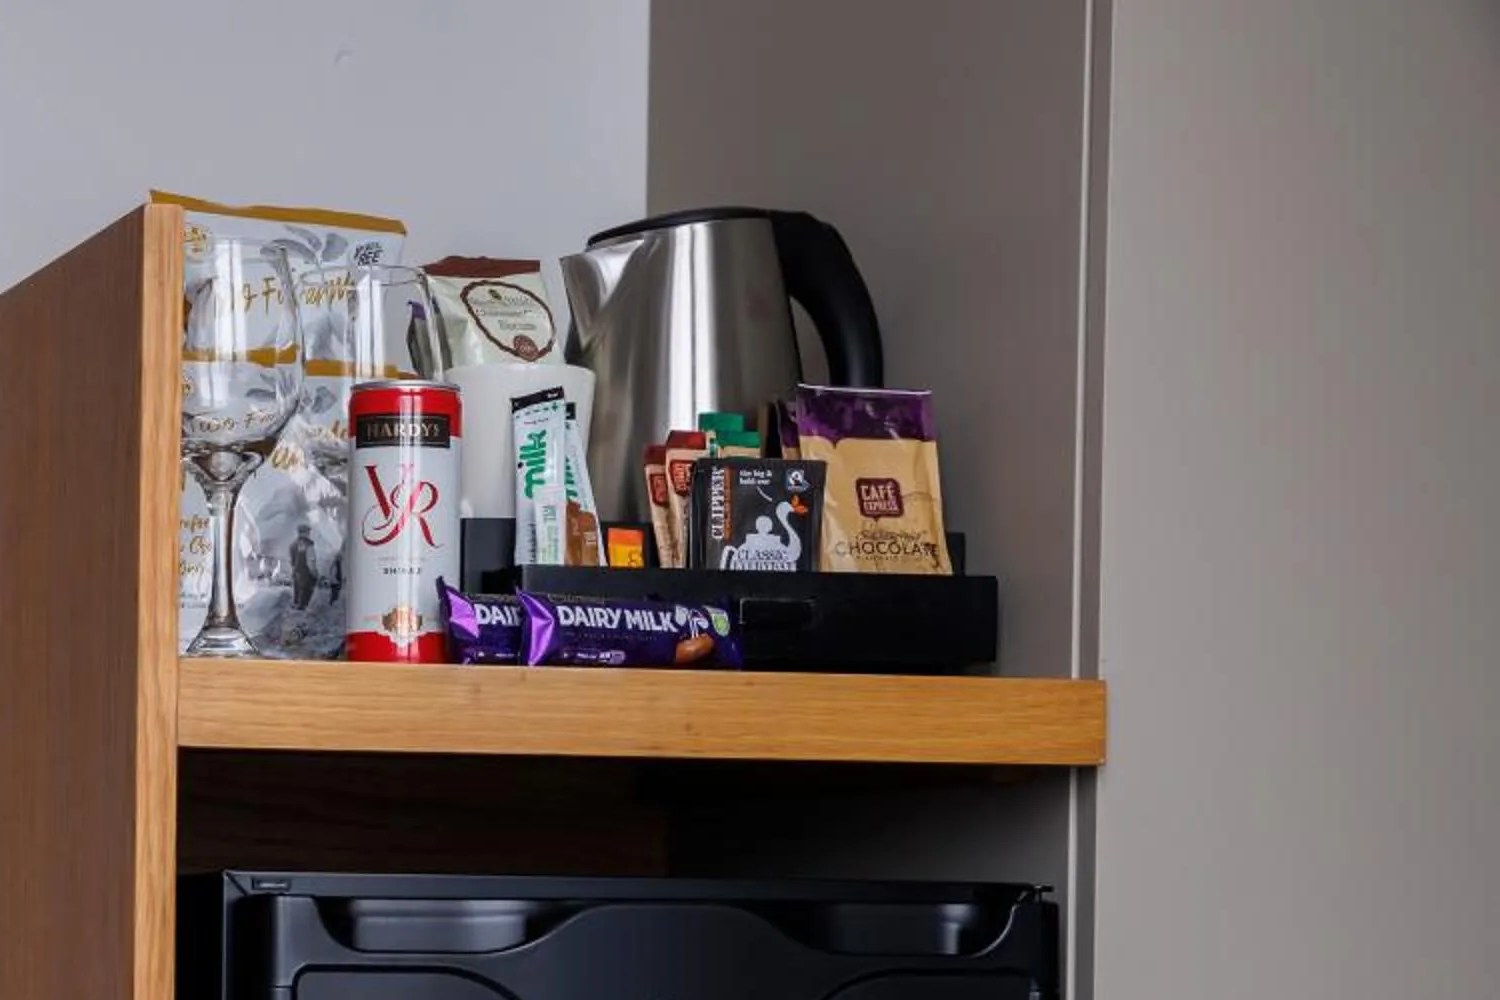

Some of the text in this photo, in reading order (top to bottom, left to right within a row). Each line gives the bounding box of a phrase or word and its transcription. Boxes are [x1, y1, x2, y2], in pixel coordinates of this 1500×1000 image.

[517, 429, 547, 498] milk
[711, 466, 725, 540] CLIPPER
[556, 605, 679, 633] DAIRY MILK
